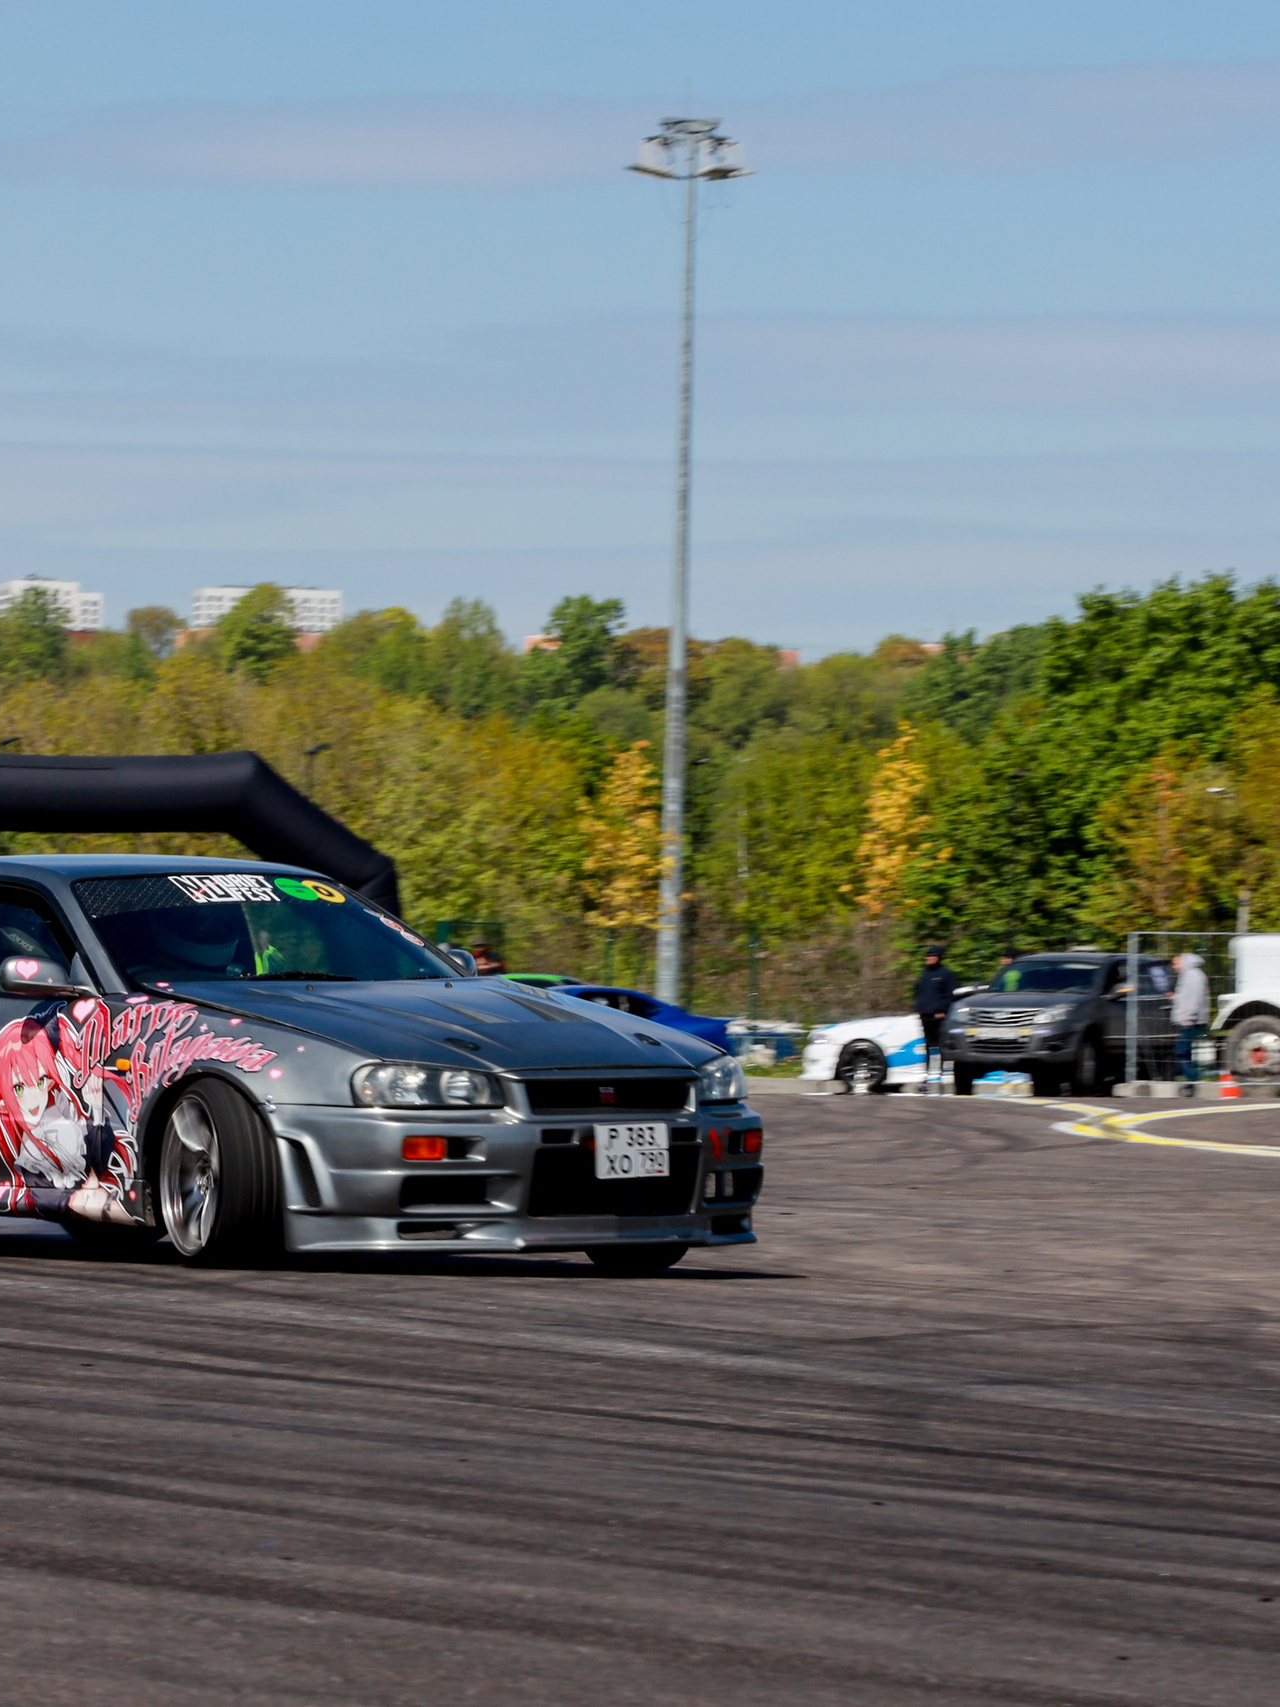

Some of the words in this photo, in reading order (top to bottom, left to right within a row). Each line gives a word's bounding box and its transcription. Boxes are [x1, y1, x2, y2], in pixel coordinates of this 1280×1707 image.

[213, 874, 273, 889] DRIFT
[228, 887, 281, 901] FEST
[625, 1126, 657, 1147] 383
